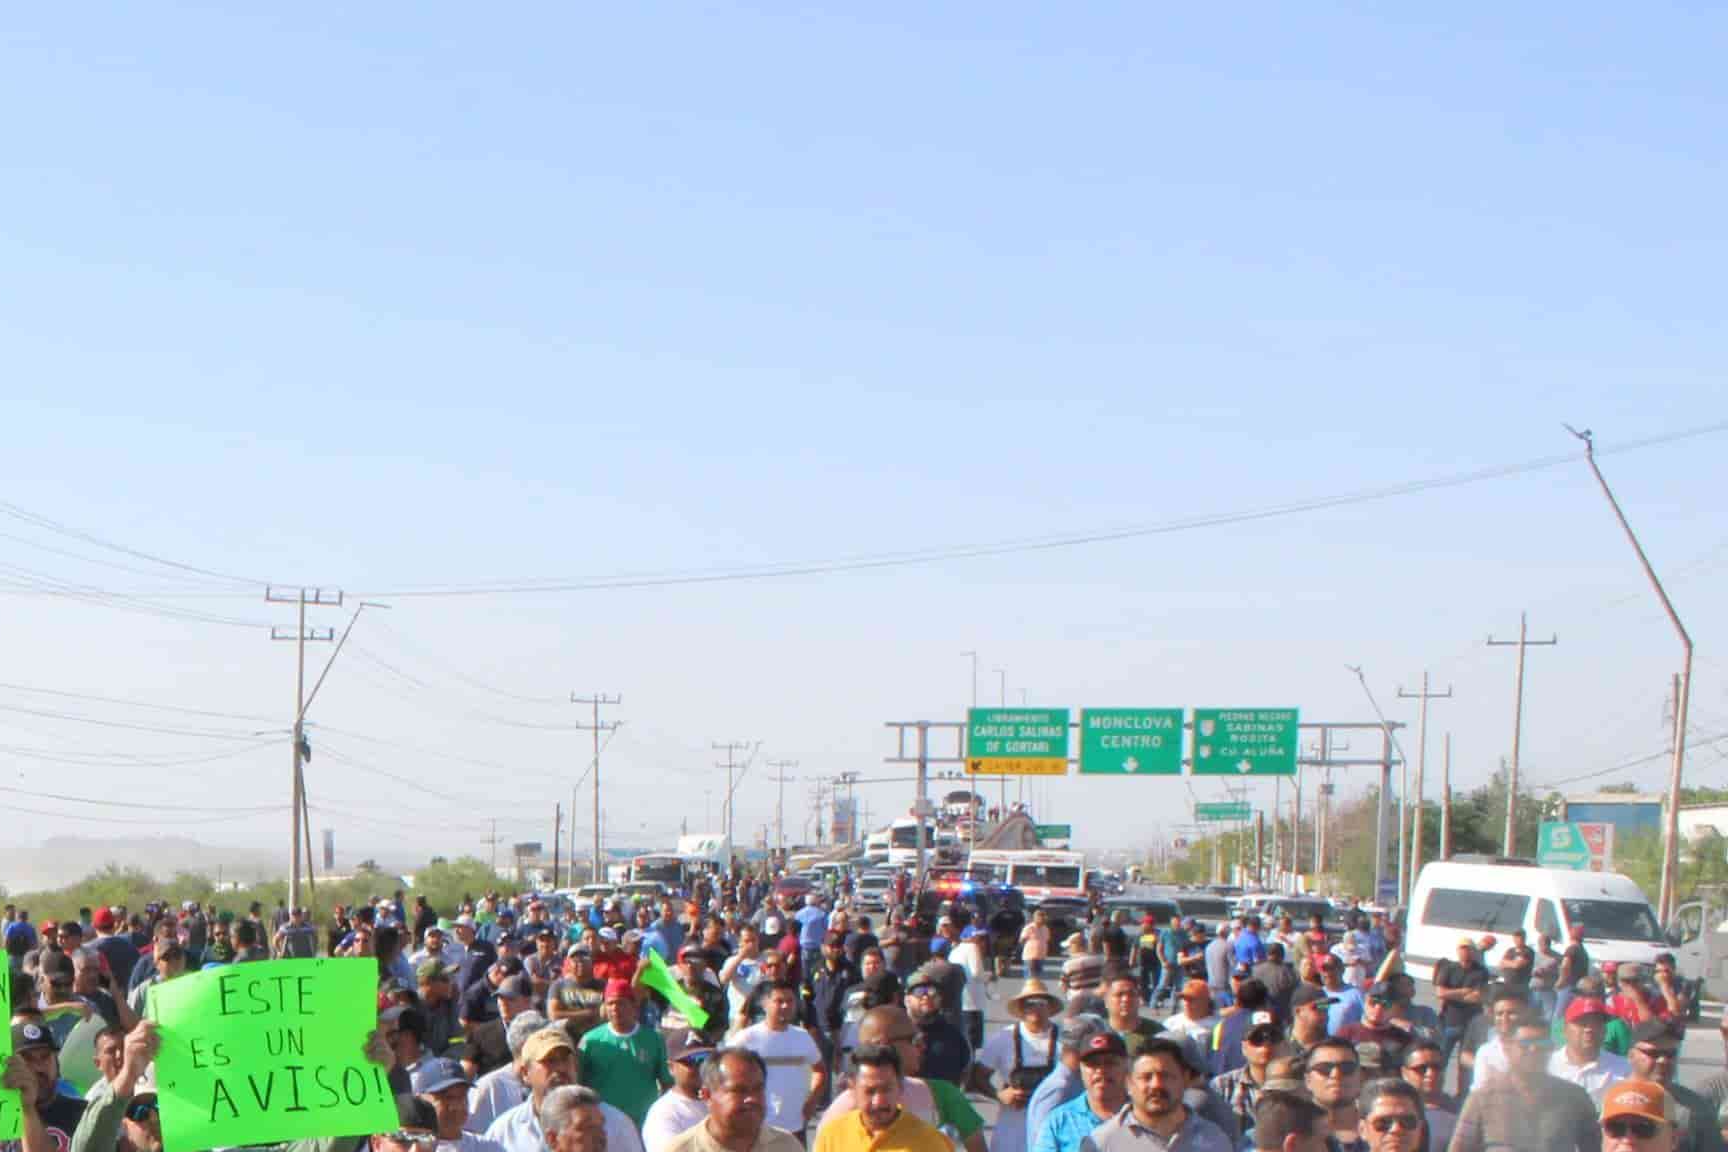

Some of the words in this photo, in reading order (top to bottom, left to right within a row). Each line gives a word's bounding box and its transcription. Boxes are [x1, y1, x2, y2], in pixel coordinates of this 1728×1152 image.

[1089, 715, 1174, 729] MONCLOVA
[1224, 722, 1285, 733] SABINAS
[1100, 735, 1163, 749] CENTRO
[218, 974, 317, 1017] ESTE
[190, 1038, 231, 1069] ES
[265, 1027, 305, 1057] UN
